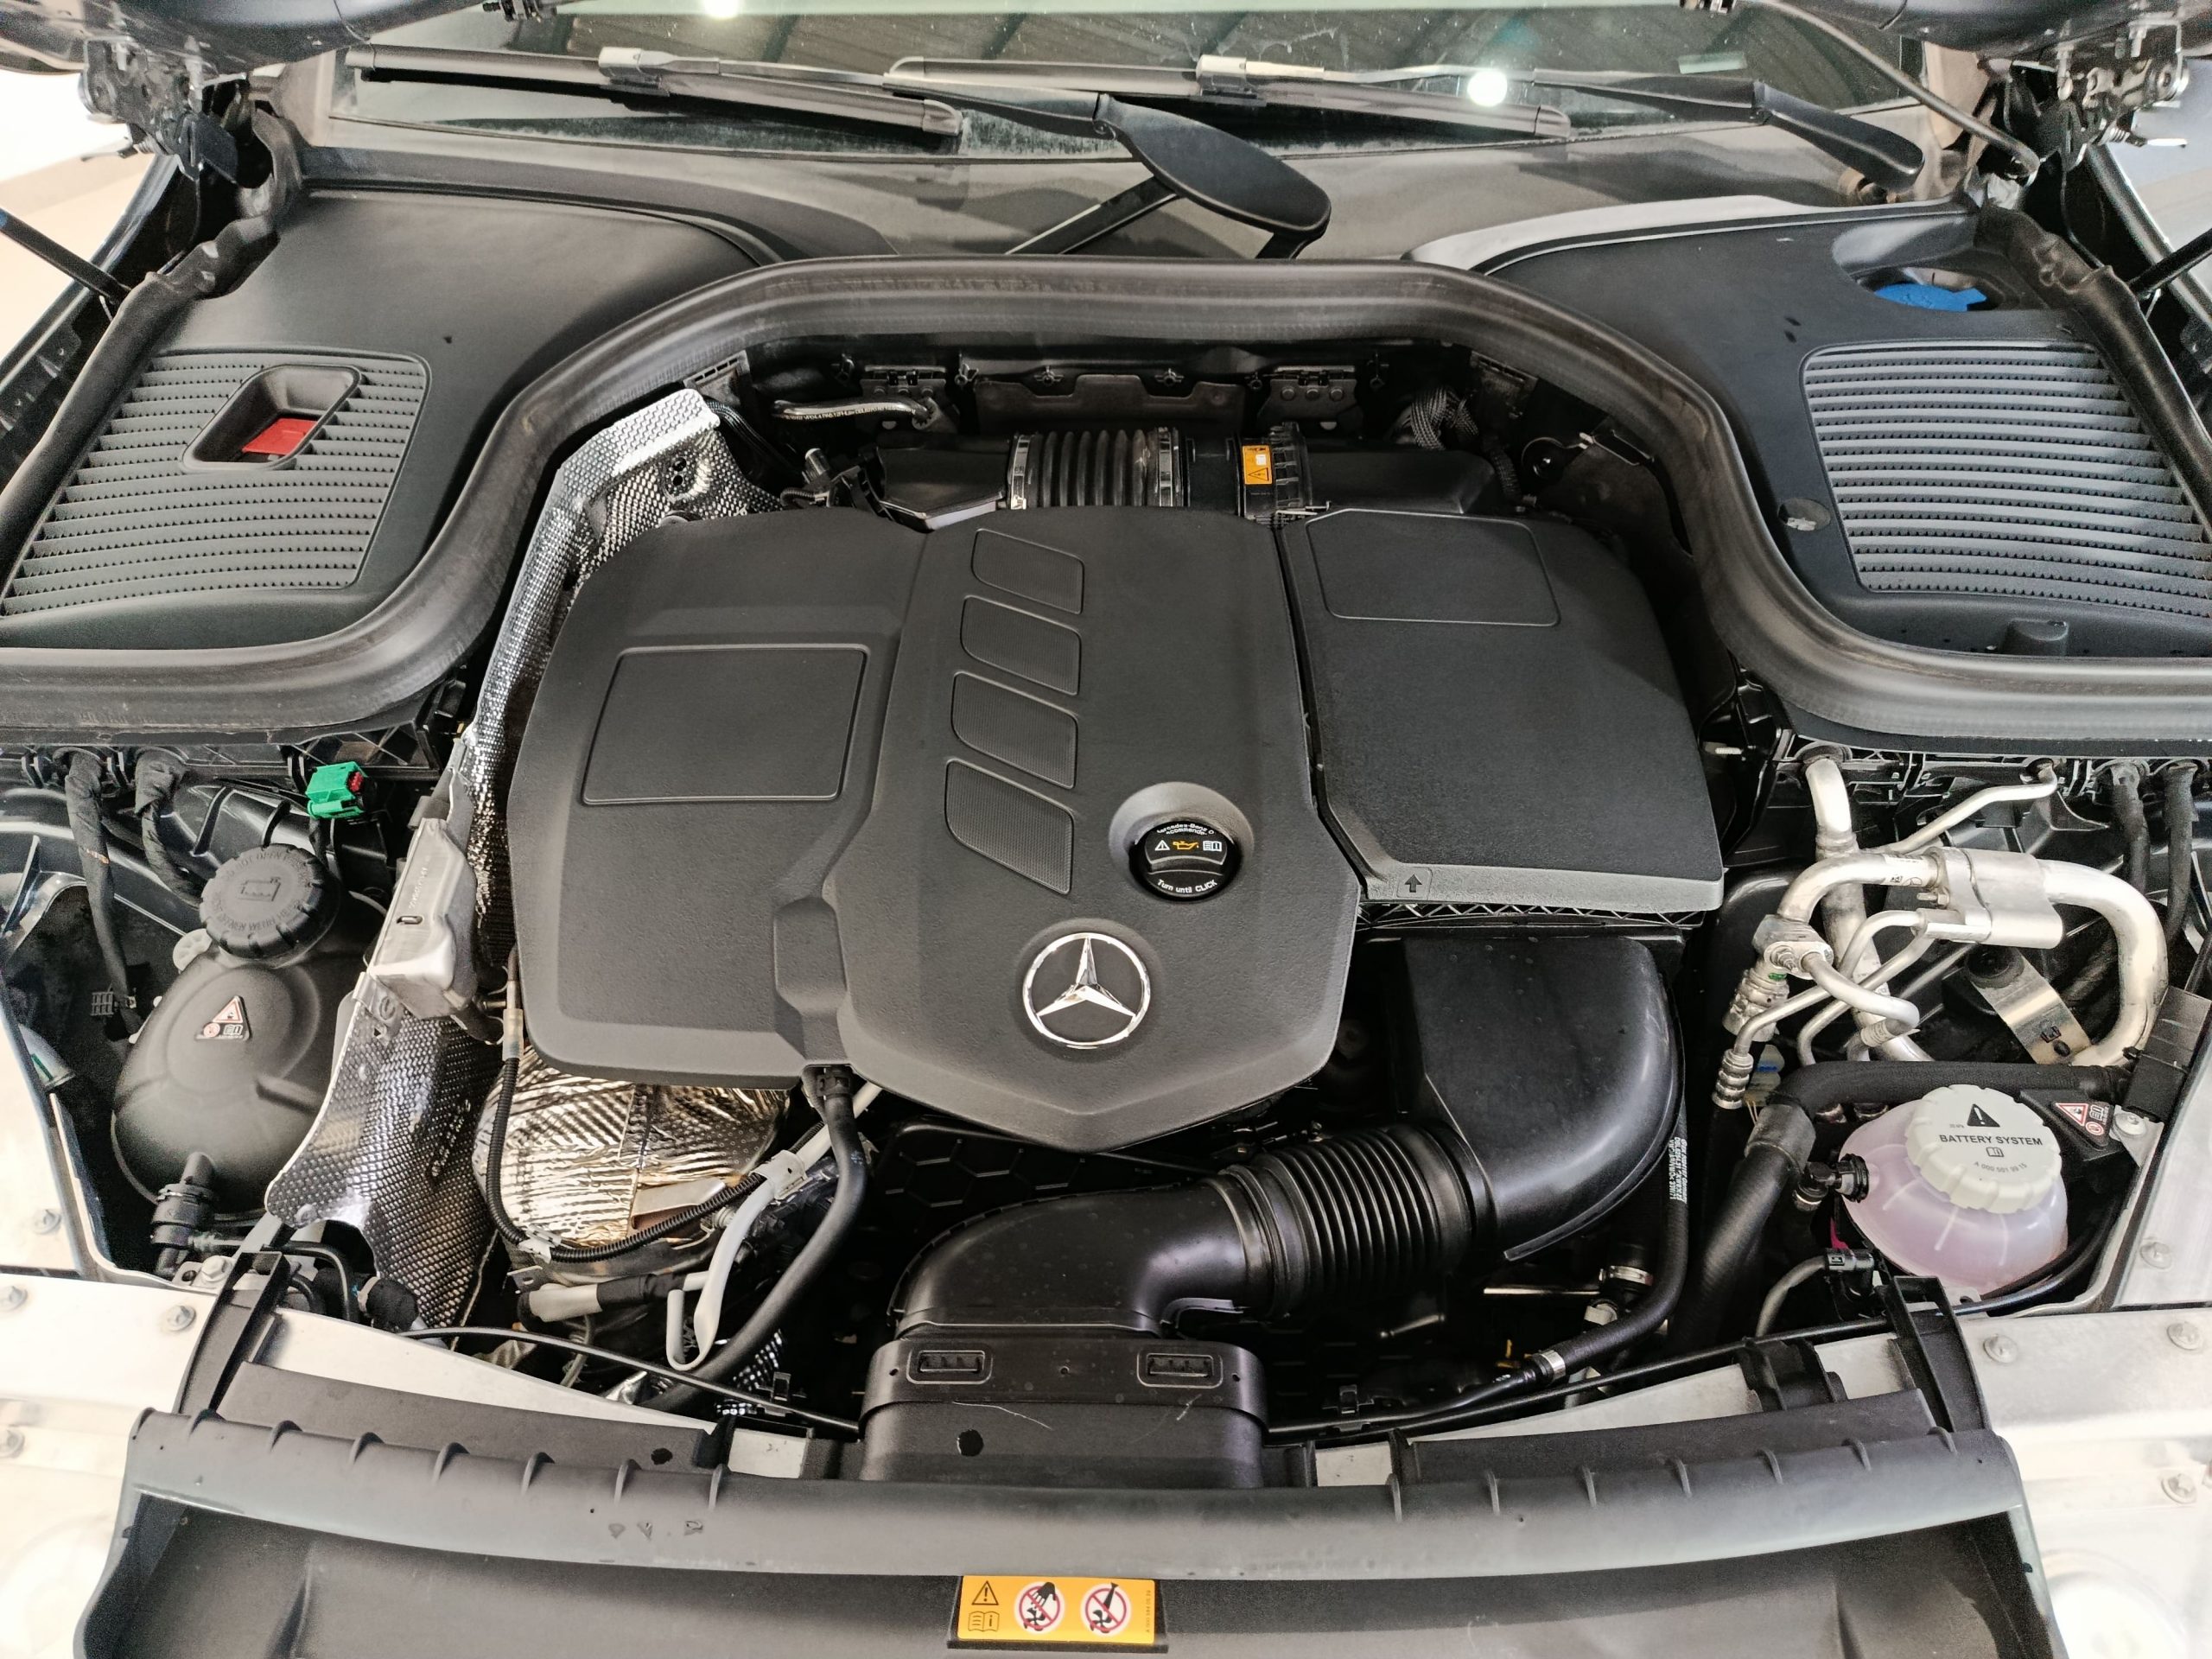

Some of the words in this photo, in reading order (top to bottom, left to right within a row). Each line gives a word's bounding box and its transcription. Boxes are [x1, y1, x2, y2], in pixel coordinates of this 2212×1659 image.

[1157, 879, 1173, 891] Turn
[1195, 880, 1217, 893] CLICK
[1939, 1135, 1992, 1143] BATTERY
[1995, 1136, 2044, 1146] SYSTEM
